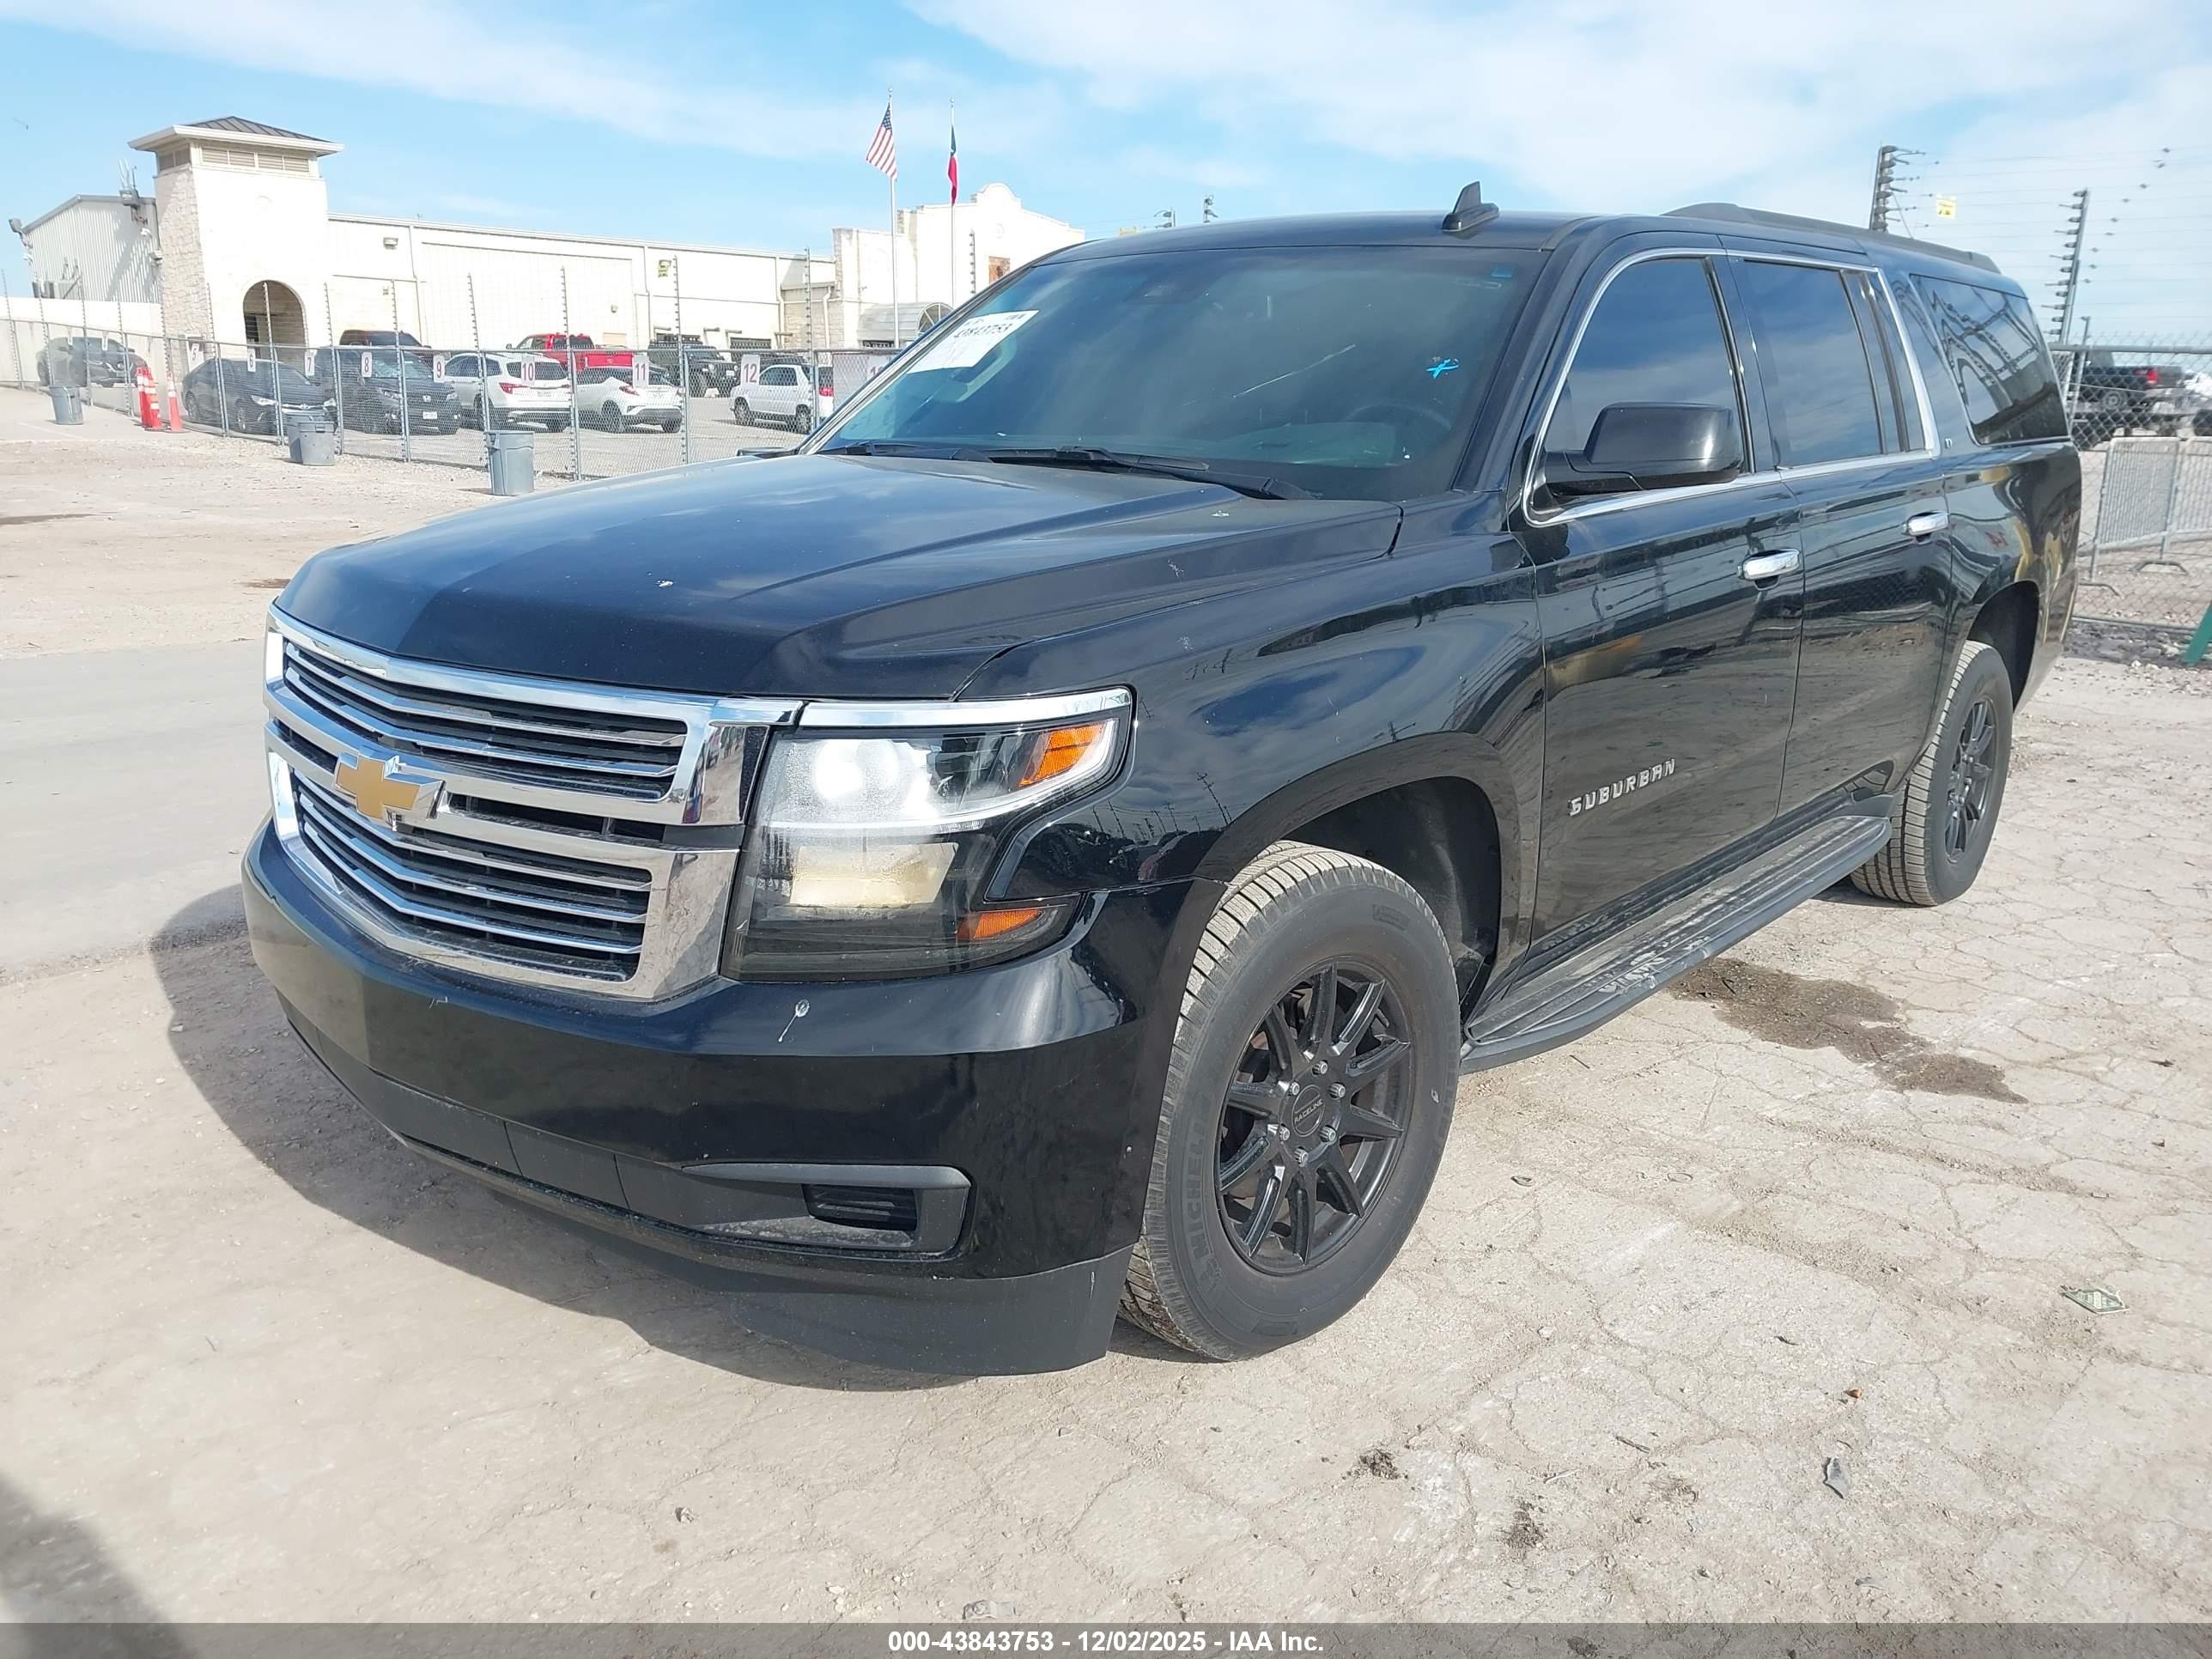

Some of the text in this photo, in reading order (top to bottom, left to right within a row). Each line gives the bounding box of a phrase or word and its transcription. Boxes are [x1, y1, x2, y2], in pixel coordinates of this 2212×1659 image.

[364, 359, 369, 372] 8
[436, 364, 442, 378] 9
[523, 364, 534, 380] 10
[635, 363, 647, 380] 11
[744, 363, 757, 382] 12
[1568, 758, 1675, 817] SUBURBAN
[1294, 1098, 1323, 1125] RACELINE
